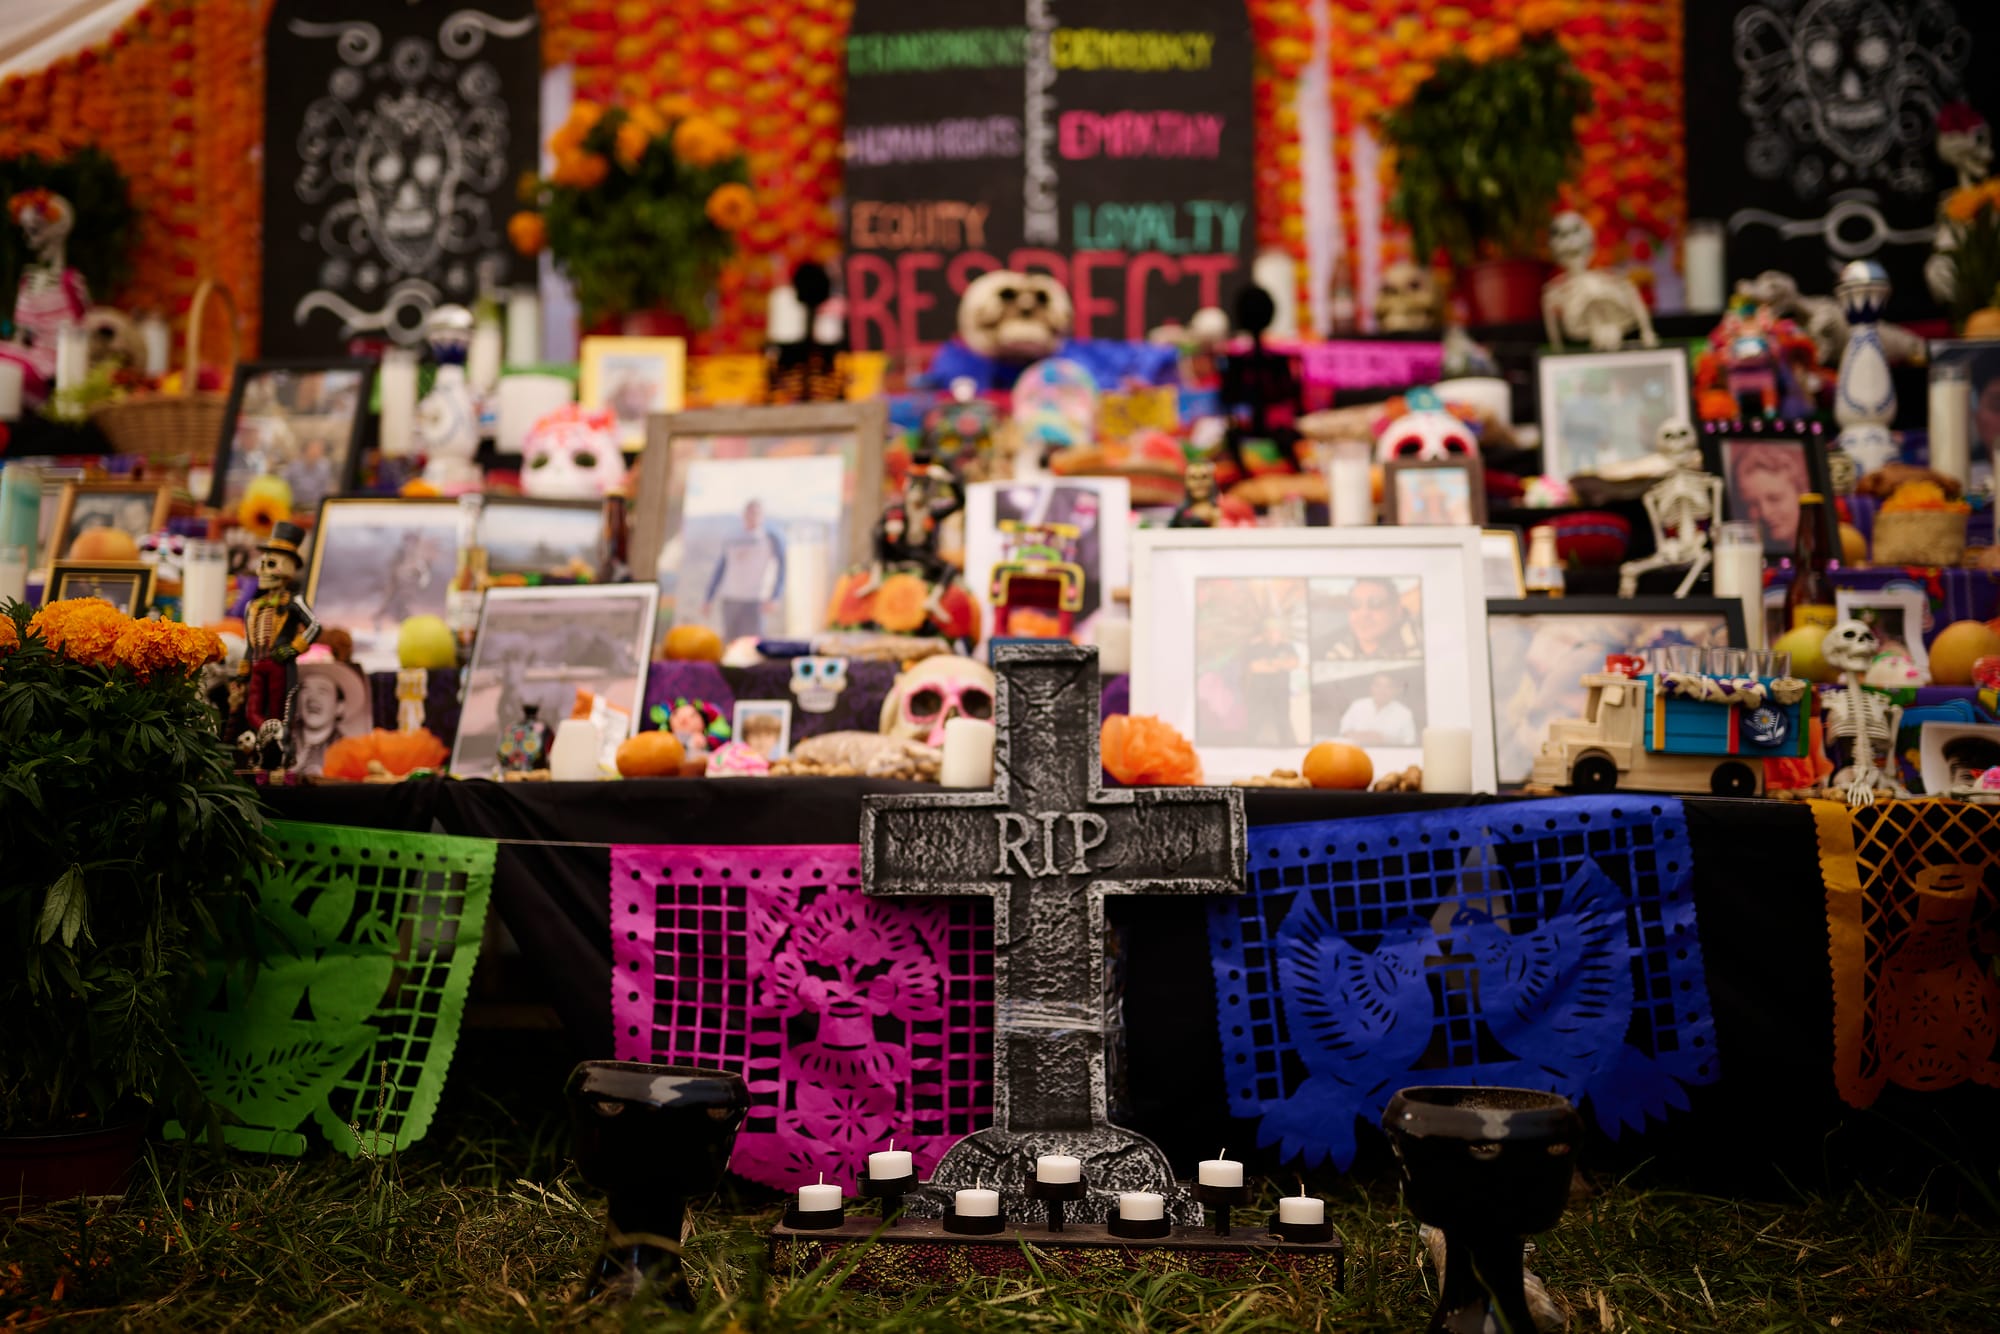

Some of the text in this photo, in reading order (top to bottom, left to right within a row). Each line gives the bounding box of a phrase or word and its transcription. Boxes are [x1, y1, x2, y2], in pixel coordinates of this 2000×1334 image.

[1059, 110, 1223, 160] EMPATHY
[851, 201, 990, 248] EQUITY
[1072, 200, 1245, 251] LOYALTY
[992, 811, 1108, 879] RIP
